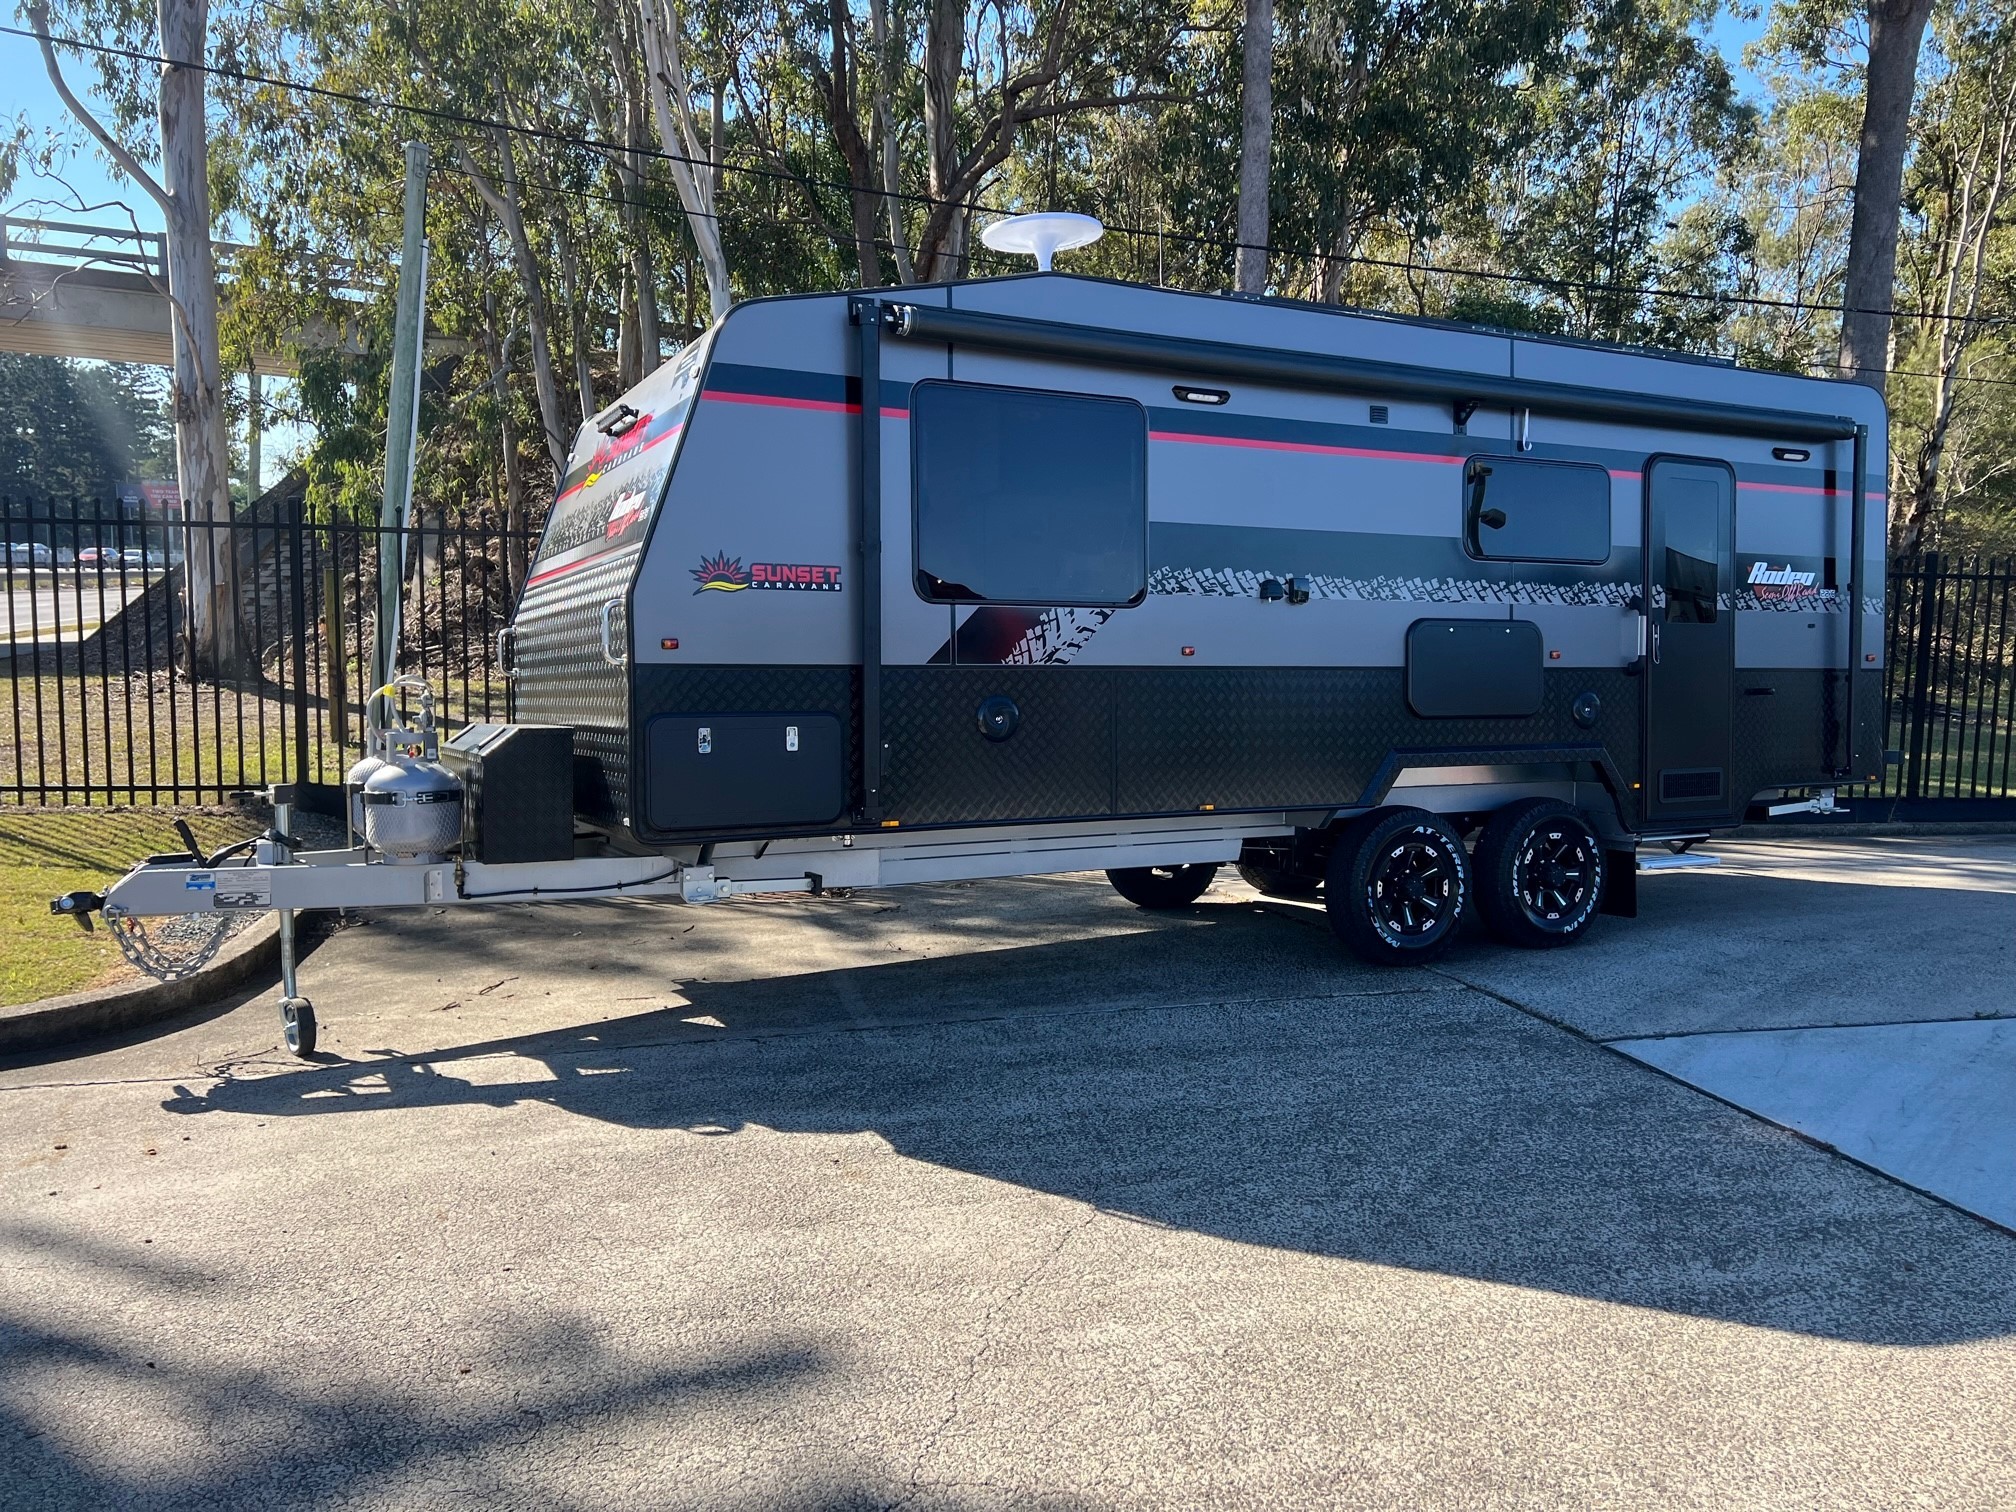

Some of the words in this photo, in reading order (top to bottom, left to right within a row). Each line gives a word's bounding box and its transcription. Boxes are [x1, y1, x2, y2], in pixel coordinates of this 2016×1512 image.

[751, 564, 840, 583] SUNSET
[751, 581, 841, 591] CARAVANS
[1747, 561, 1816, 586] Rodeo
[1412, 825, 1465, 919] AT-TERRAIN
[1563, 835, 1602, 934] AT-TERRAIN
